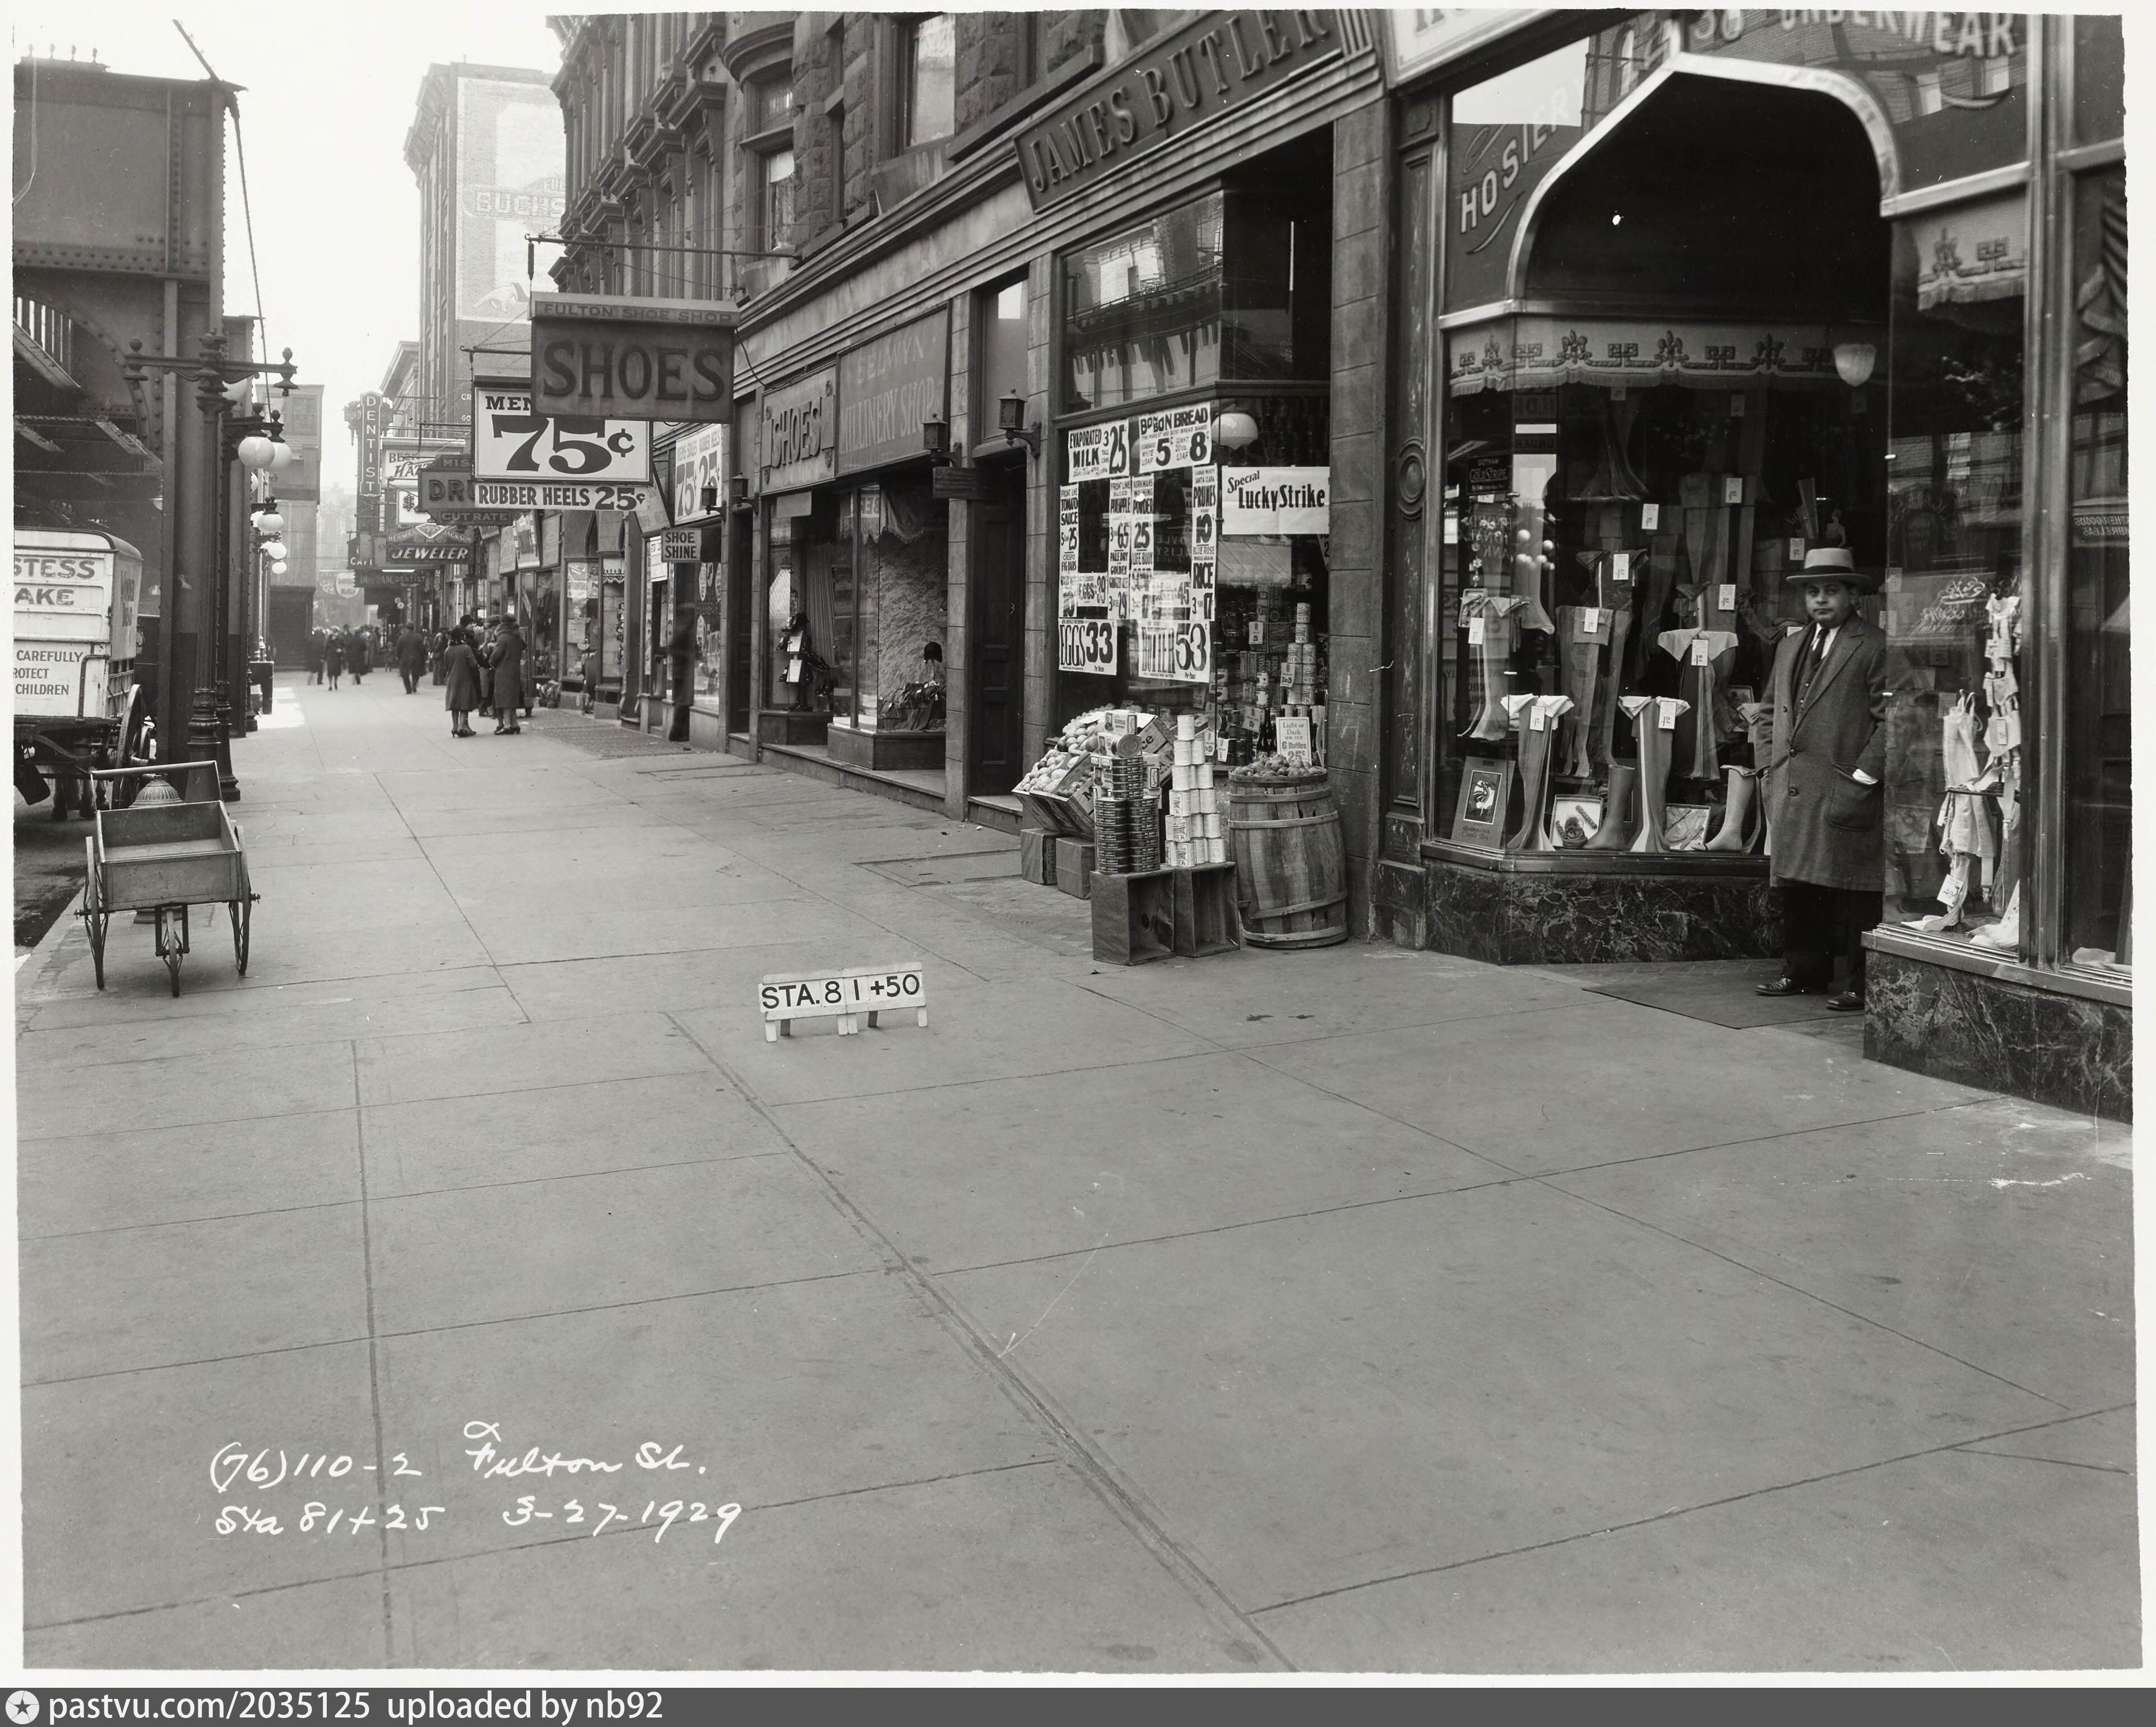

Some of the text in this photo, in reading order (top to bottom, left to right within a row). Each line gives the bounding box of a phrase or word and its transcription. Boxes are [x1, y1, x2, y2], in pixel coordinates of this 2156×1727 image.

[1029, 87, 1136, 192] JAMES
[544, 303, 732, 325] FULTON SHOE SHOP
[543, 340, 725, 401] SHOES
[841, 377, 935, 453] MILLINERY SHOP
[1174, 407, 1208, 428] BREAD
[366, 397, 377, 491] DENTIST
[1070, 429, 1109, 448] EVAPORATED 3
[1073, 448, 1100, 468] MILK
[1227, 470, 1260, 494] Special
[479, 485, 537, 505] RUBBER
[543, 487, 590, 507] HEELS
[1061, 496, 1078, 513] TOMATO
[1193, 485, 1216, 508] PRUNES
[1110, 497, 1130, 513] PINEAPPLE
[1133, 498, 1153, 515] POWDER
[442, 512, 508, 521] CUT RATE
[1060, 512, 1078, 526] SAUCE
[444, 530, 472, 542] JACKSON
[665, 532, 696, 544] SHOE
[391, 547, 469, 560] JEWELER
[665, 545, 697, 559] SHINE
[1110, 553, 1120, 561] PALE
[1132, 552, 1141, 565] LIFE
[1203, 546, 1214, 555] ROSE
[1068, 561, 1077, 571] BARS
[1110, 565, 1127, 575] GOLDEN
[1193, 563, 1213, 589] RICE
[1078, 582, 1095, 600] EGGS
[1109, 596, 1112, 611] 3
[1192, 597, 1197, 614] 3
[1059, 624, 1086, 667] EGGS
[16, 650, 84, 662] CAREFULLY
[15, 684, 69, 695] CHILDREN
[1282, 741, 1287, 750] 6
